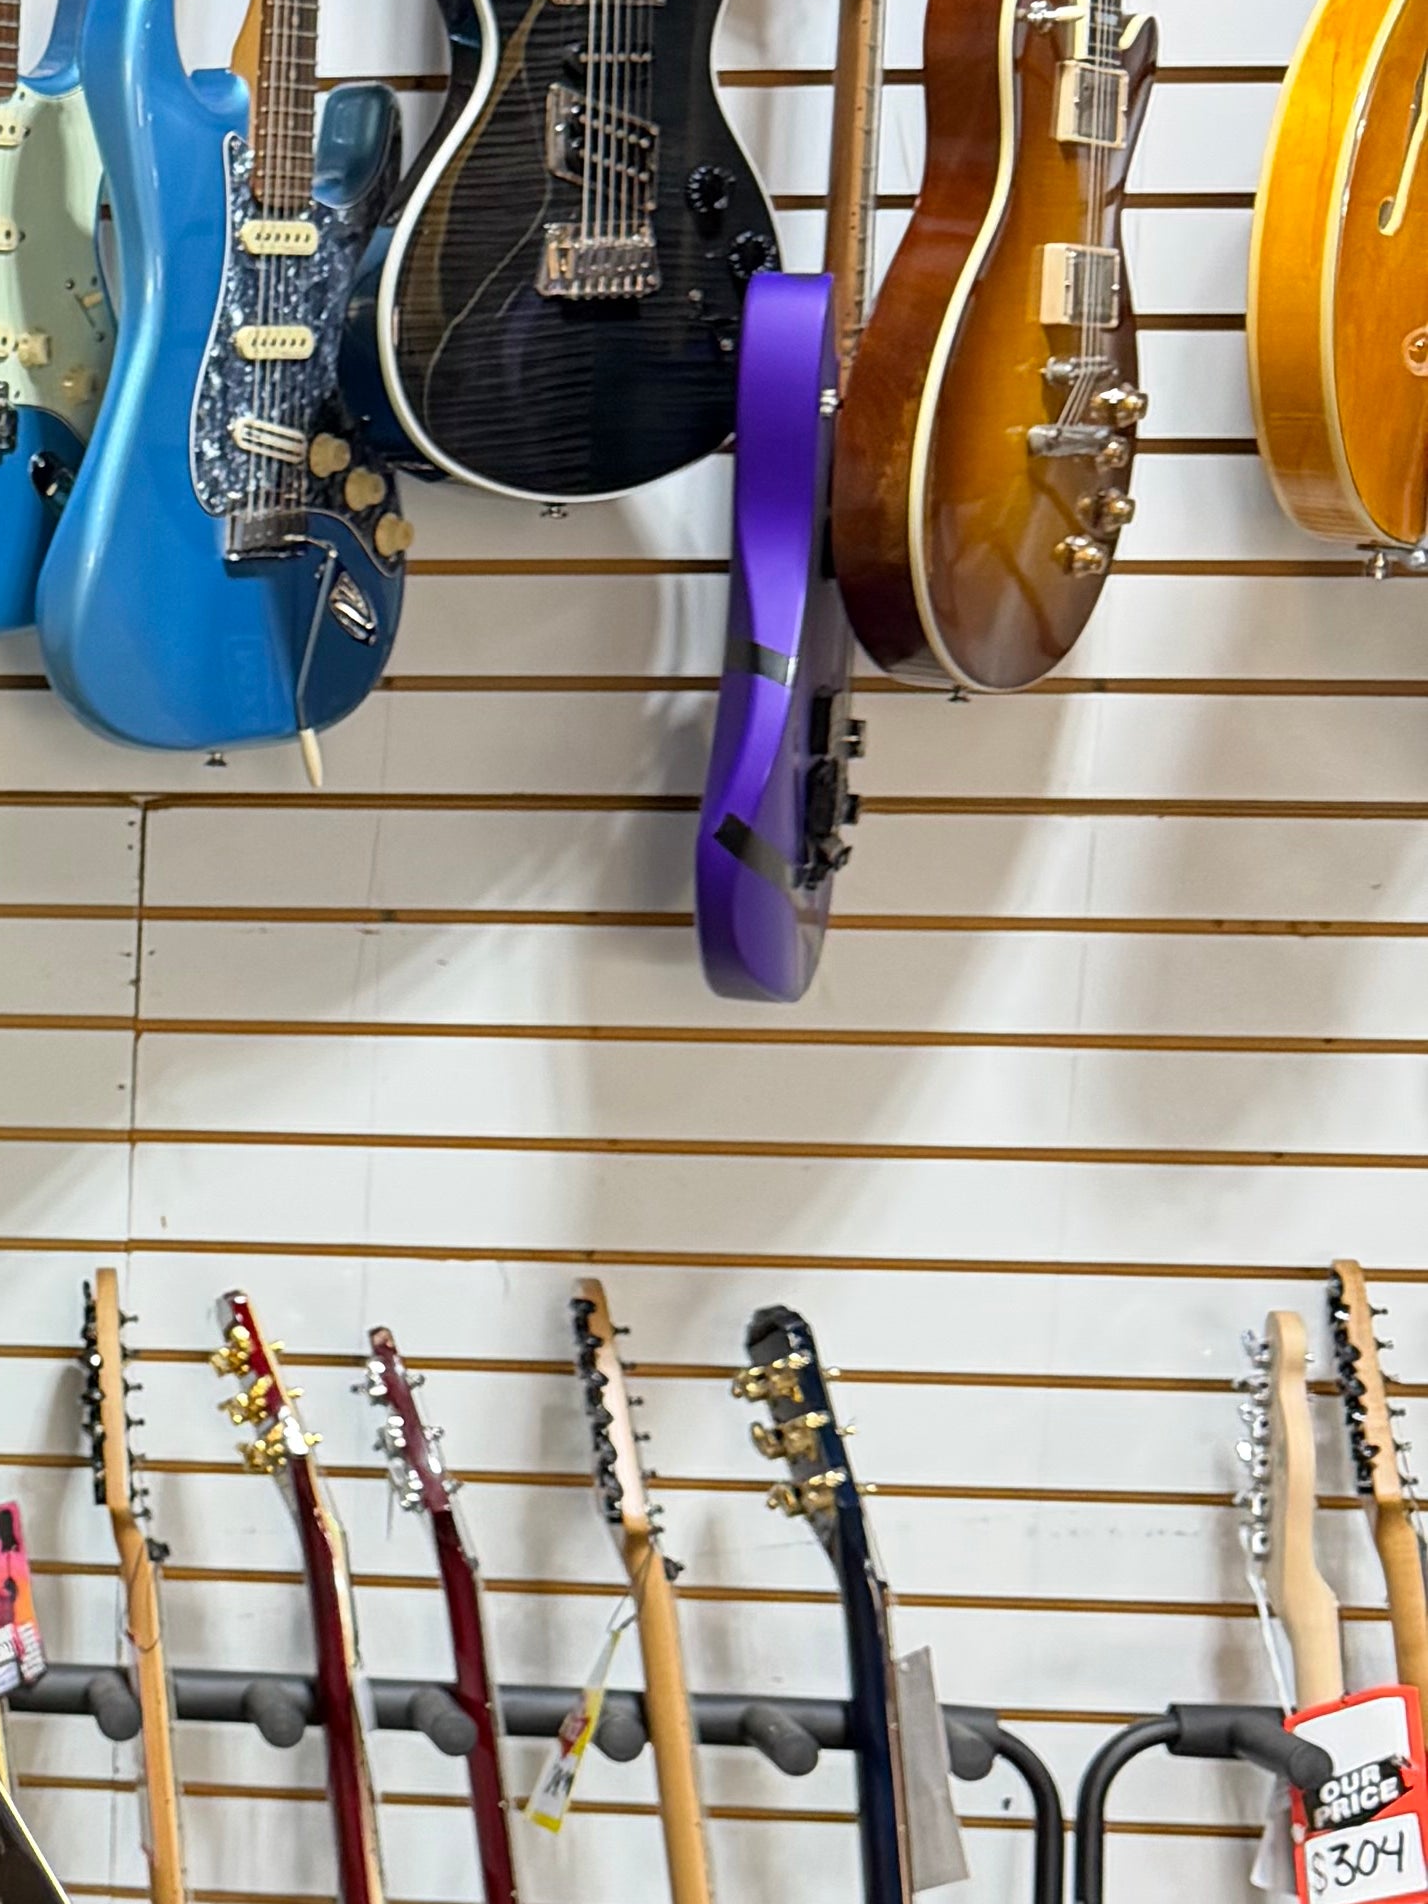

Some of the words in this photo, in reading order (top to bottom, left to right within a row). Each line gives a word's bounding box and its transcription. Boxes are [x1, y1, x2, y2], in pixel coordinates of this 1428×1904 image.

[1313, 1776, 1401, 1829] PRICE
[1318, 1763, 1382, 1805] OUR
[1311, 1829, 1405, 1895] $304
